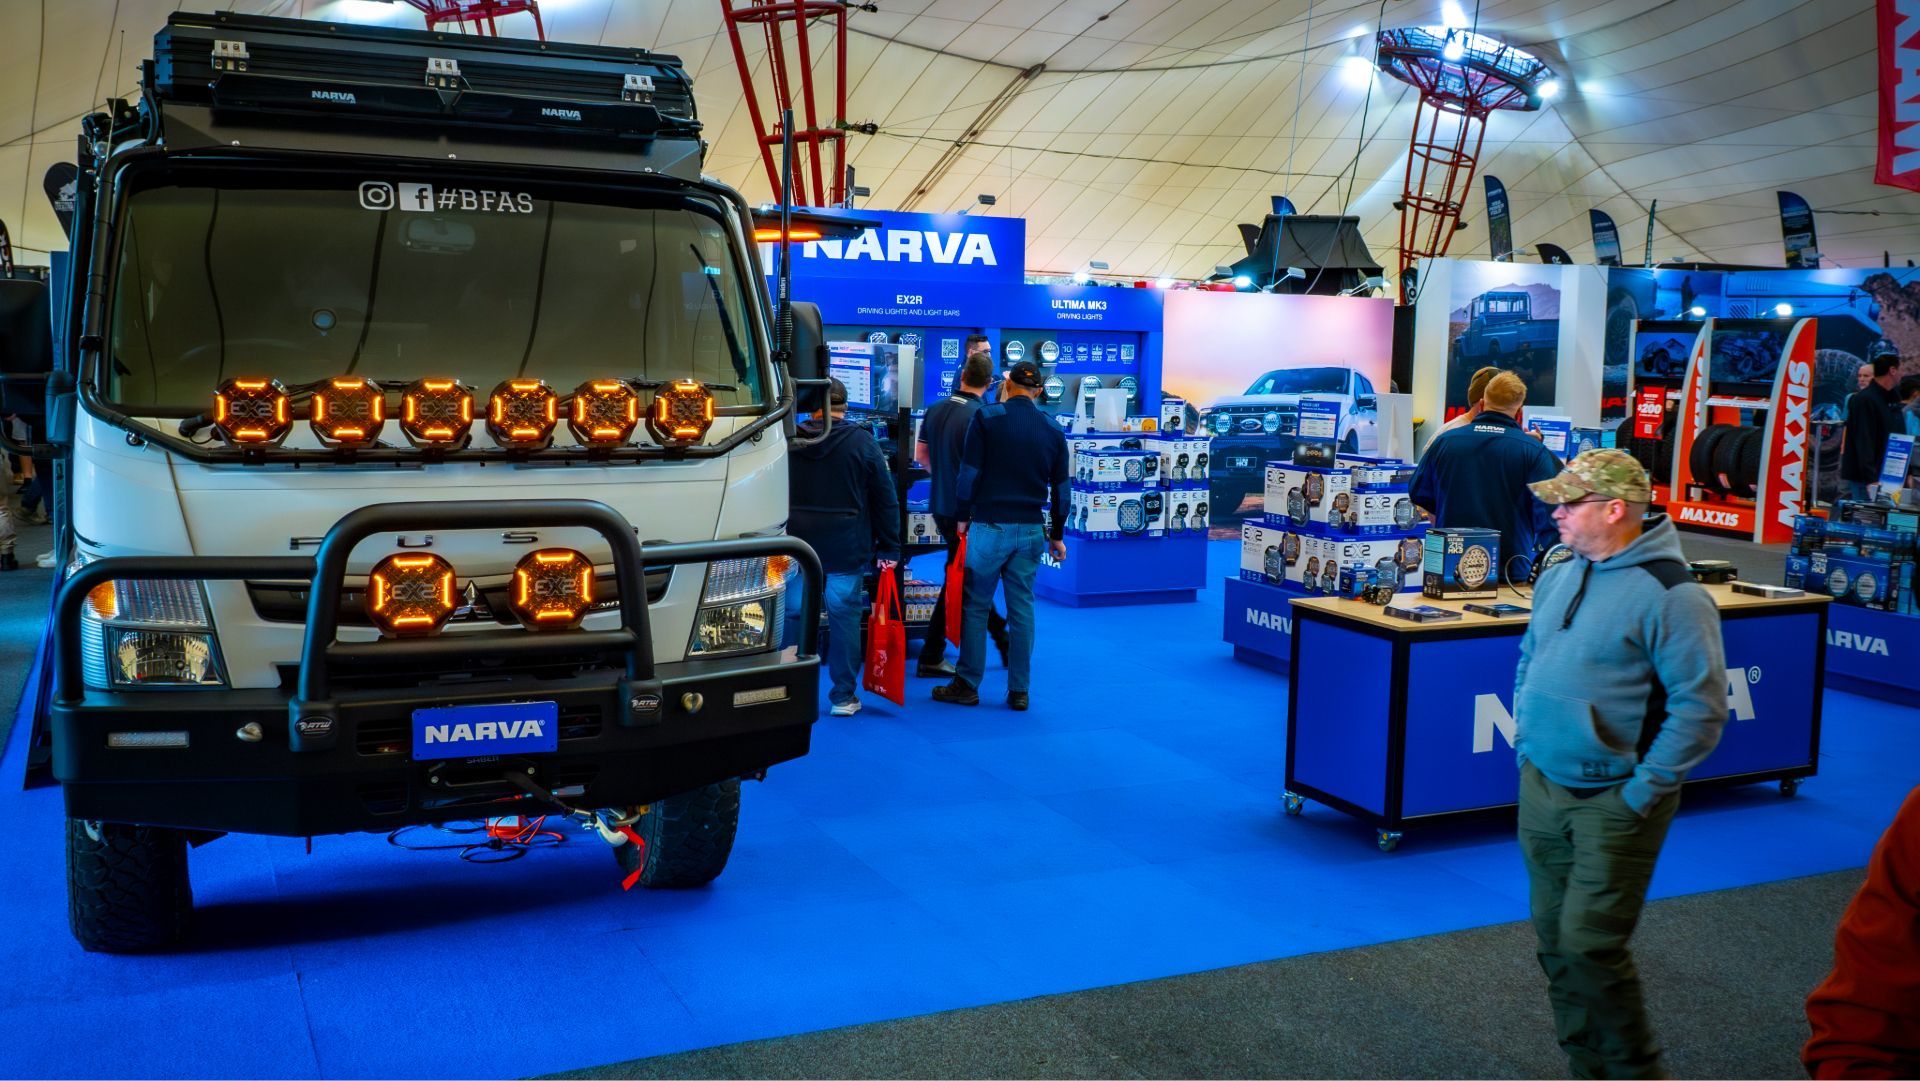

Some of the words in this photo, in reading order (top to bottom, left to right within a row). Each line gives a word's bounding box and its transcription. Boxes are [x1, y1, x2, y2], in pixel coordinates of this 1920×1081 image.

[312, 90, 355, 101] NARVA
[542, 108, 581, 118] NARVA
[438, 189, 533, 213] #BFAS
[803, 228, 998, 266] NARVA
[896, 295, 922, 305] EX2R
[1052, 300, 1086, 310] ULTIMA
[1088, 301, 1107, 311] MK3
[1637, 403, 1662, 415] $200
[1680, 506, 1739, 526] MAXXIS
[1246, 607, 1293, 635] NARV
